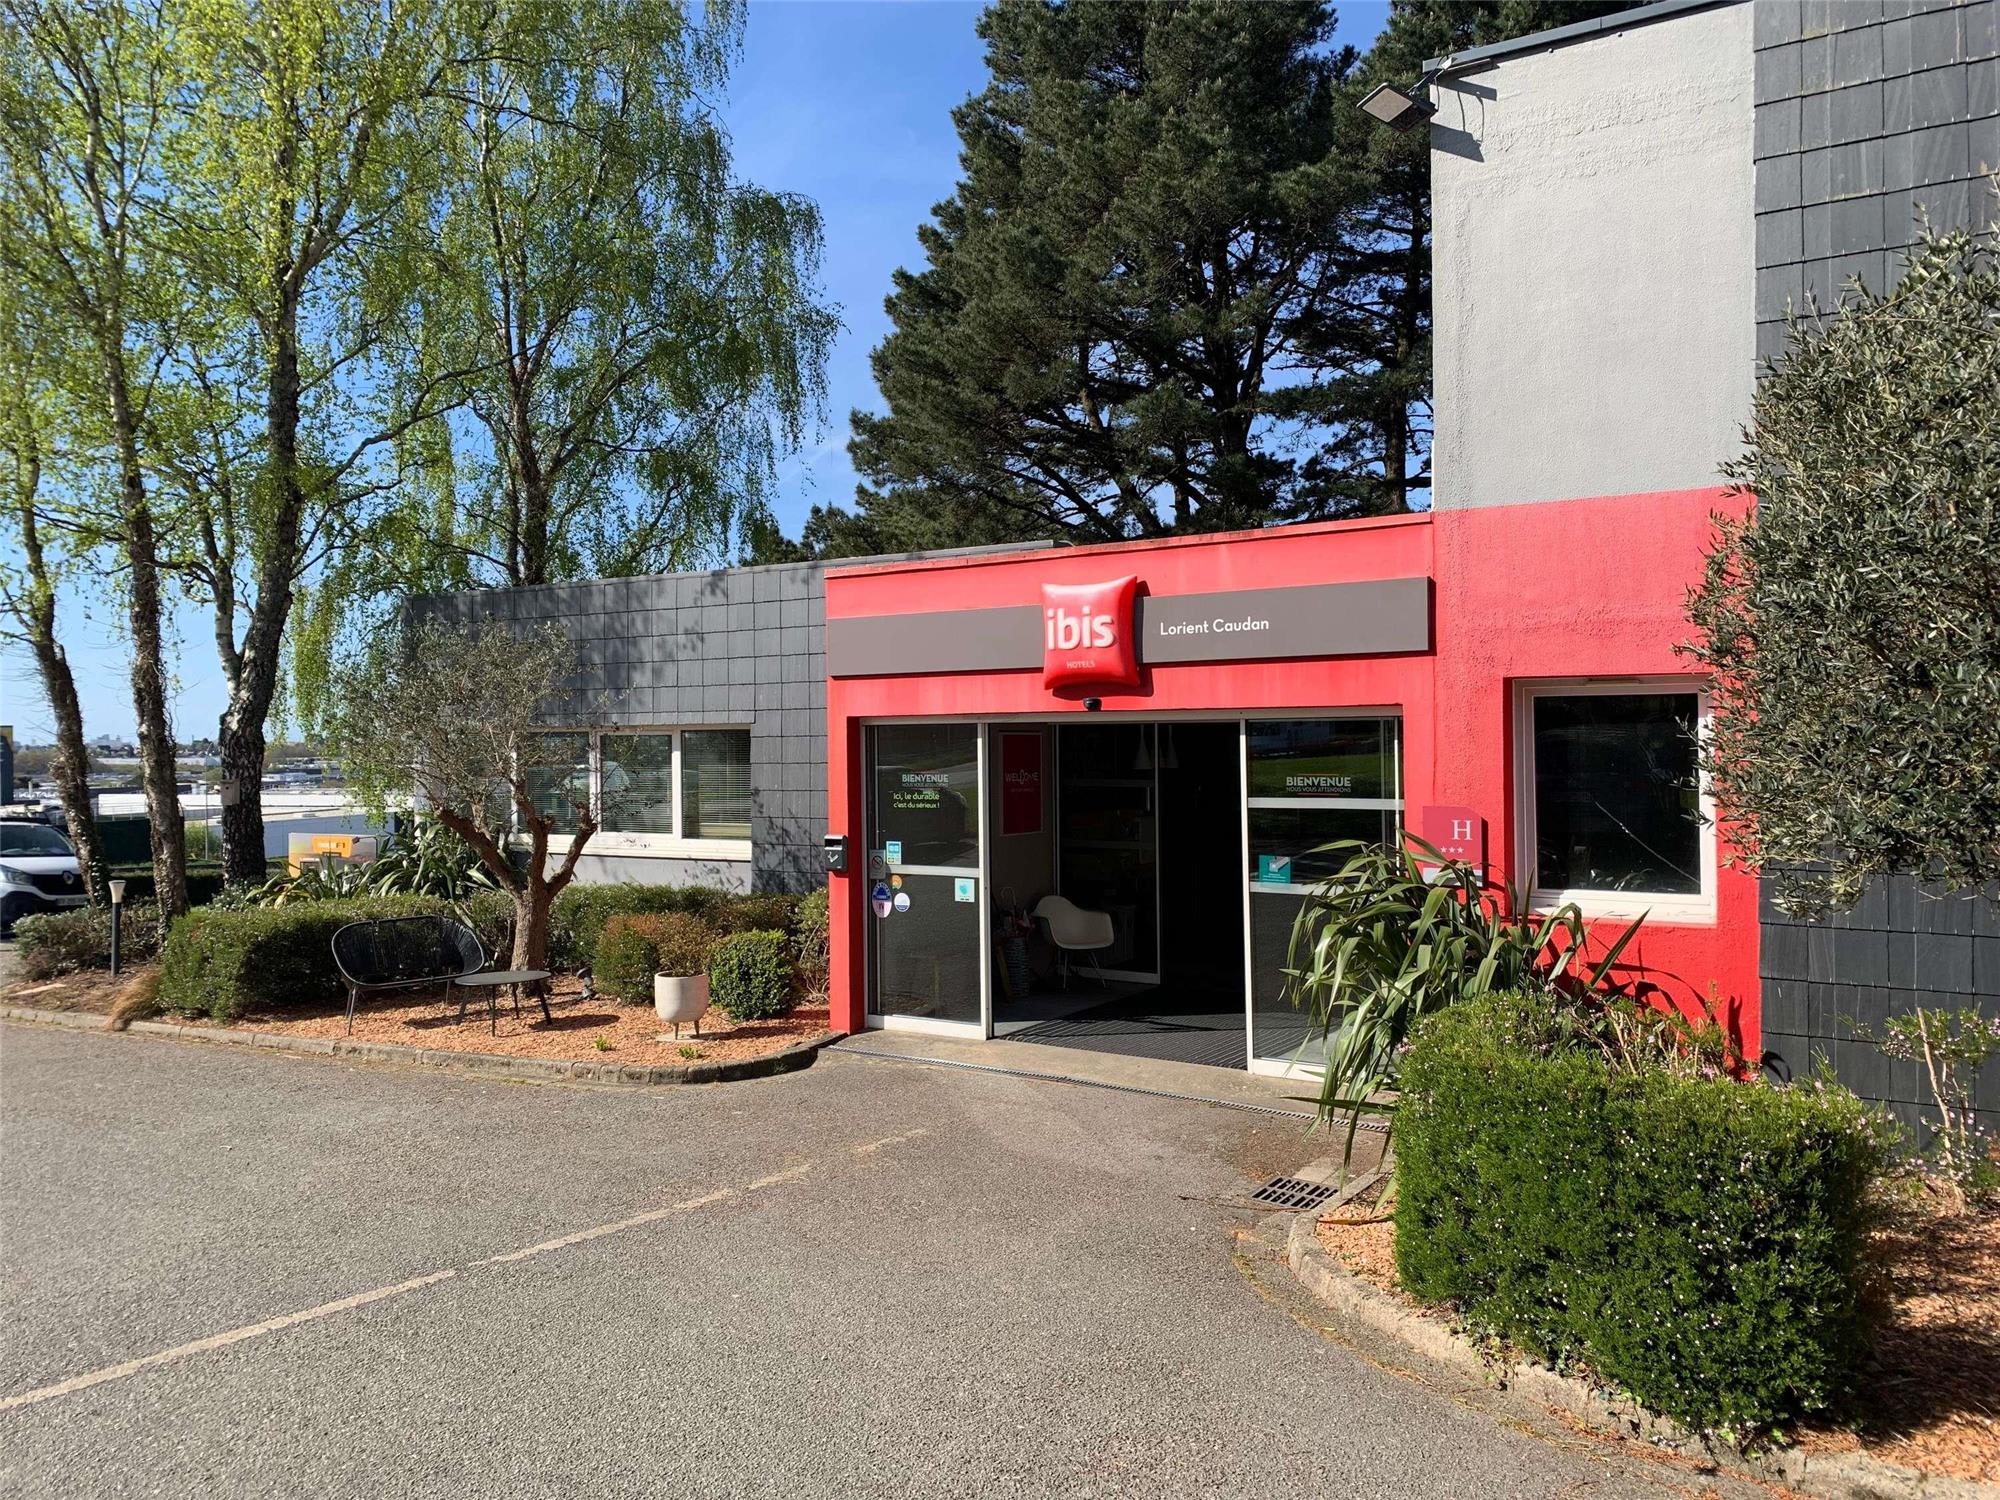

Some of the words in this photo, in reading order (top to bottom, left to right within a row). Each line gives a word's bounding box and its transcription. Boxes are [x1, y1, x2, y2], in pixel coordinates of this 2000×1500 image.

[1047, 605, 1115, 650] ibis
[1160, 621, 1209, 636] Lorient
[1213, 616, 1269, 634] Caudan
[1066, 659, 1096, 669] HOTELS
[901, 774, 949, 783] BIENVENUE
[1286, 776, 1352, 787] BIENVENUE
[905, 792, 911, 800] le
[912, 791, 940, 800] durable
[1452, 819, 1472, 840] H
